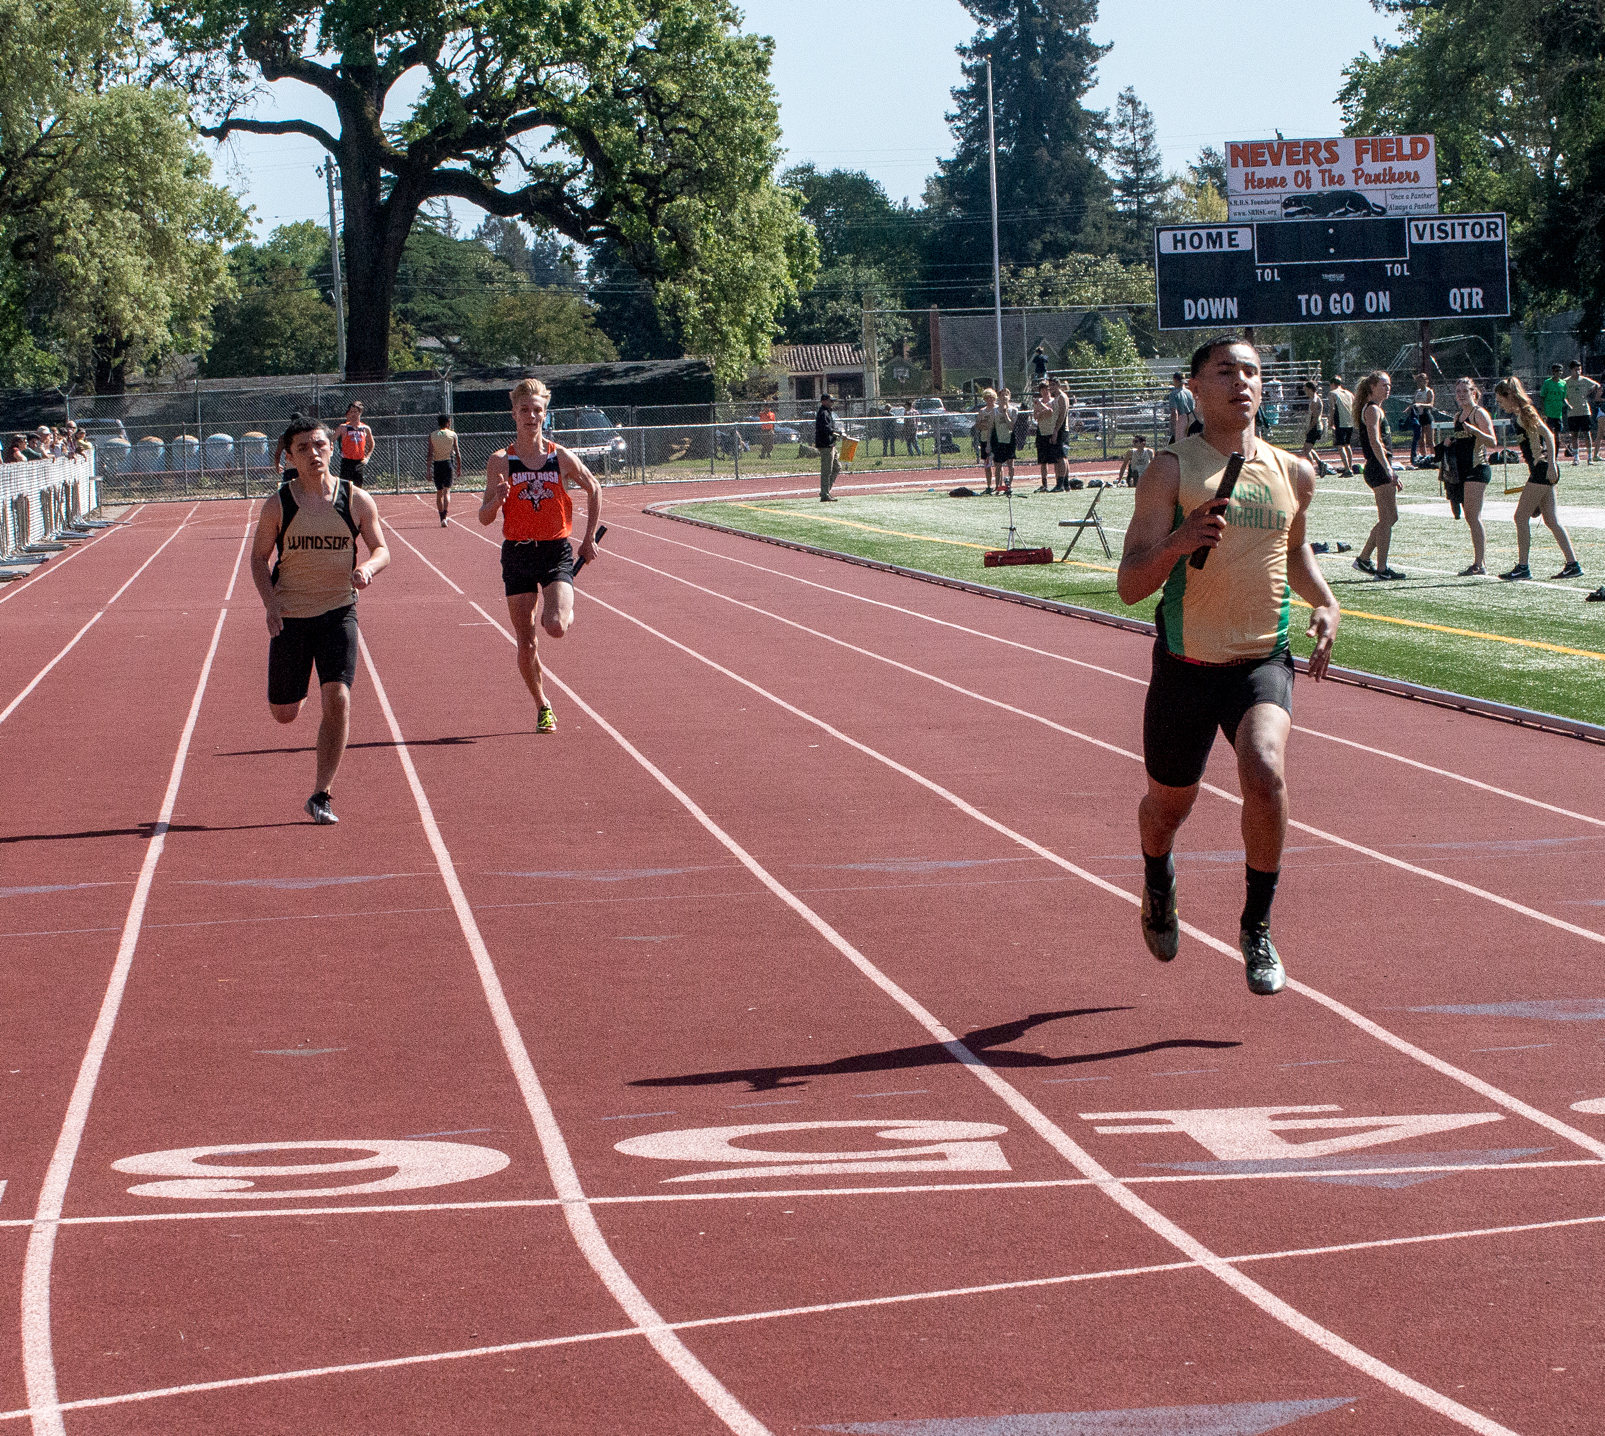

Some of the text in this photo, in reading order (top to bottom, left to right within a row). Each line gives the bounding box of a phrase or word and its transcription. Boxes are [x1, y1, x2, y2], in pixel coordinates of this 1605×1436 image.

[1230, 137, 1430, 167] NEVERS FIELD
[1244, 166, 1420, 190] Home Of The Panthers
[1172, 231, 1239, 251] HOME
[1414, 220, 1499, 241] VISITOR
[1184, 297, 1238, 320] DOWN
[1298, 291, 1390, 316] TO GO ON
[1449, 287, 1483, 312] QTR
[511, 471, 559, 486] SANTA ROSA
[1225, 505, 1286, 530] ARRILLO
[286, 535, 350, 550] WINDSOR
